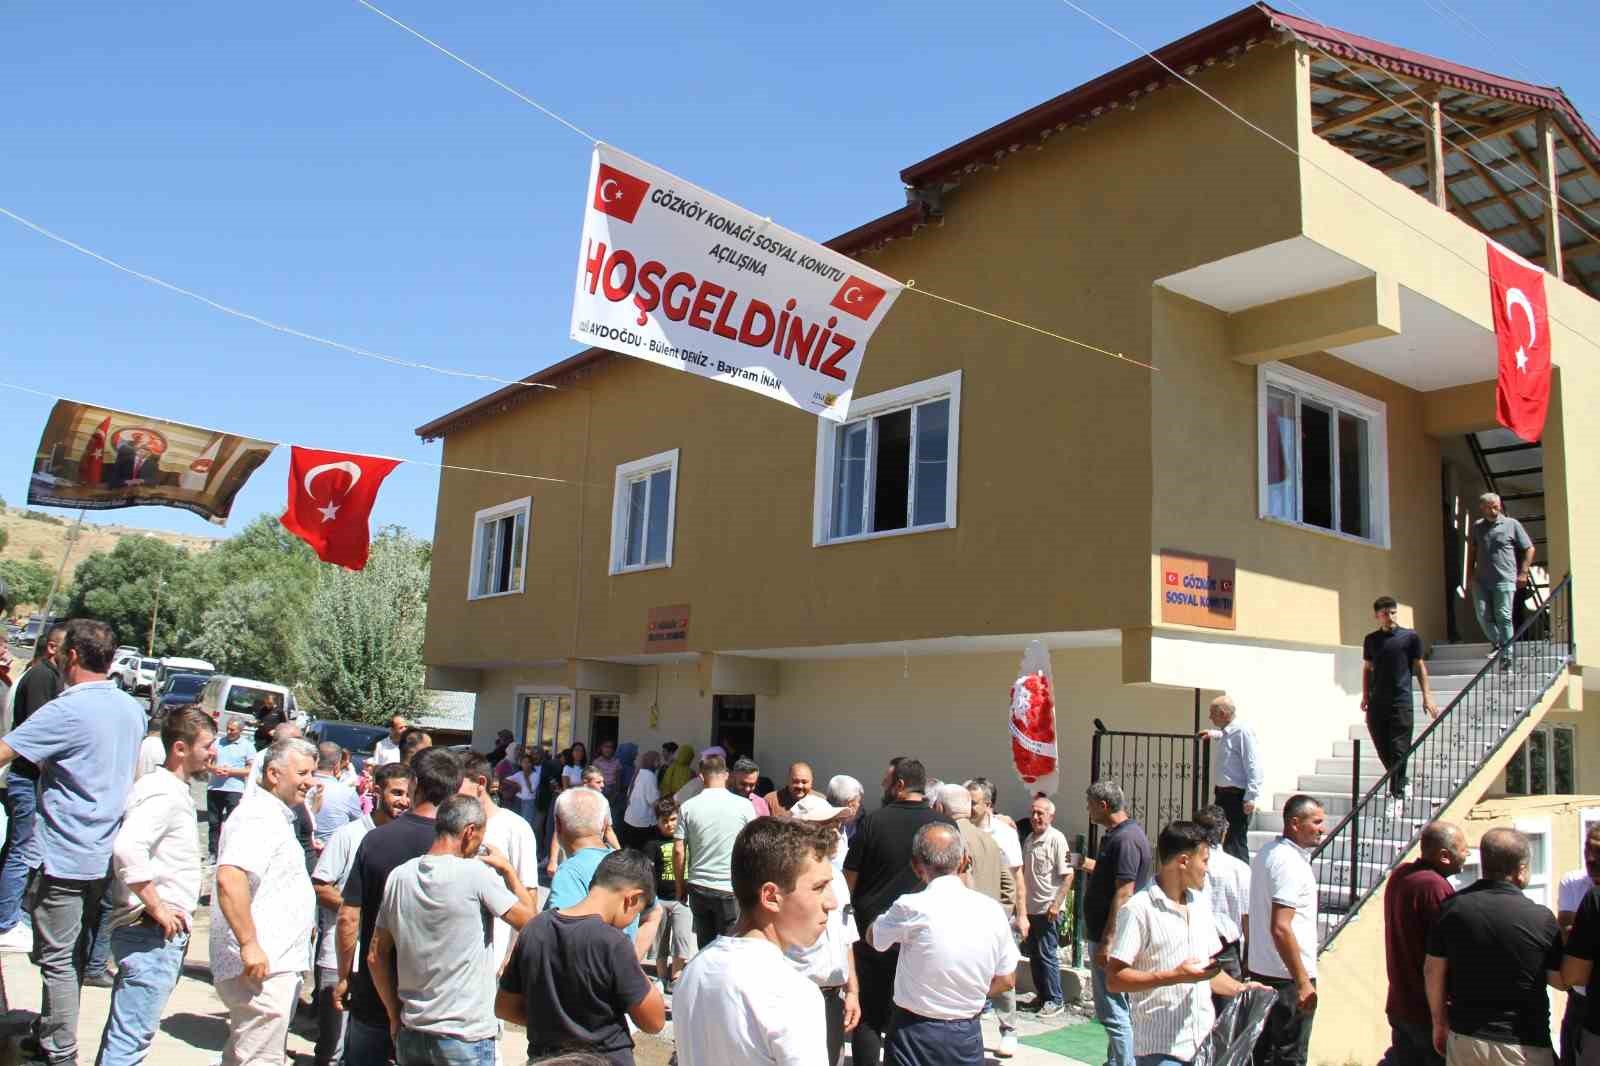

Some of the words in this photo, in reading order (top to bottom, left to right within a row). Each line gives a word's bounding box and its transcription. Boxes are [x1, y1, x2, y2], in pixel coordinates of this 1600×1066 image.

[651, 188, 708, 221] GÖZKÖY
[704, 212, 756, 243] KONAĞI
[752, 234, 798, 263] SOSYAL
[797, 254, 845, 283] KONUTU
[709, 243, 768, 276] AÇILIŞINA
[584, 238, 857, 382] HOŞGELDİNİZ
[589, 322, 643, 346] AYDOĞDU
[649, 339, 680, 359] Bülent
[681, 347, 709, 368] DENİZ
[716, 360, 759, 383] Bayram
[759, 370, 782, 391] İNAN
[1166, 591, 1198, 607] SOSYAL
